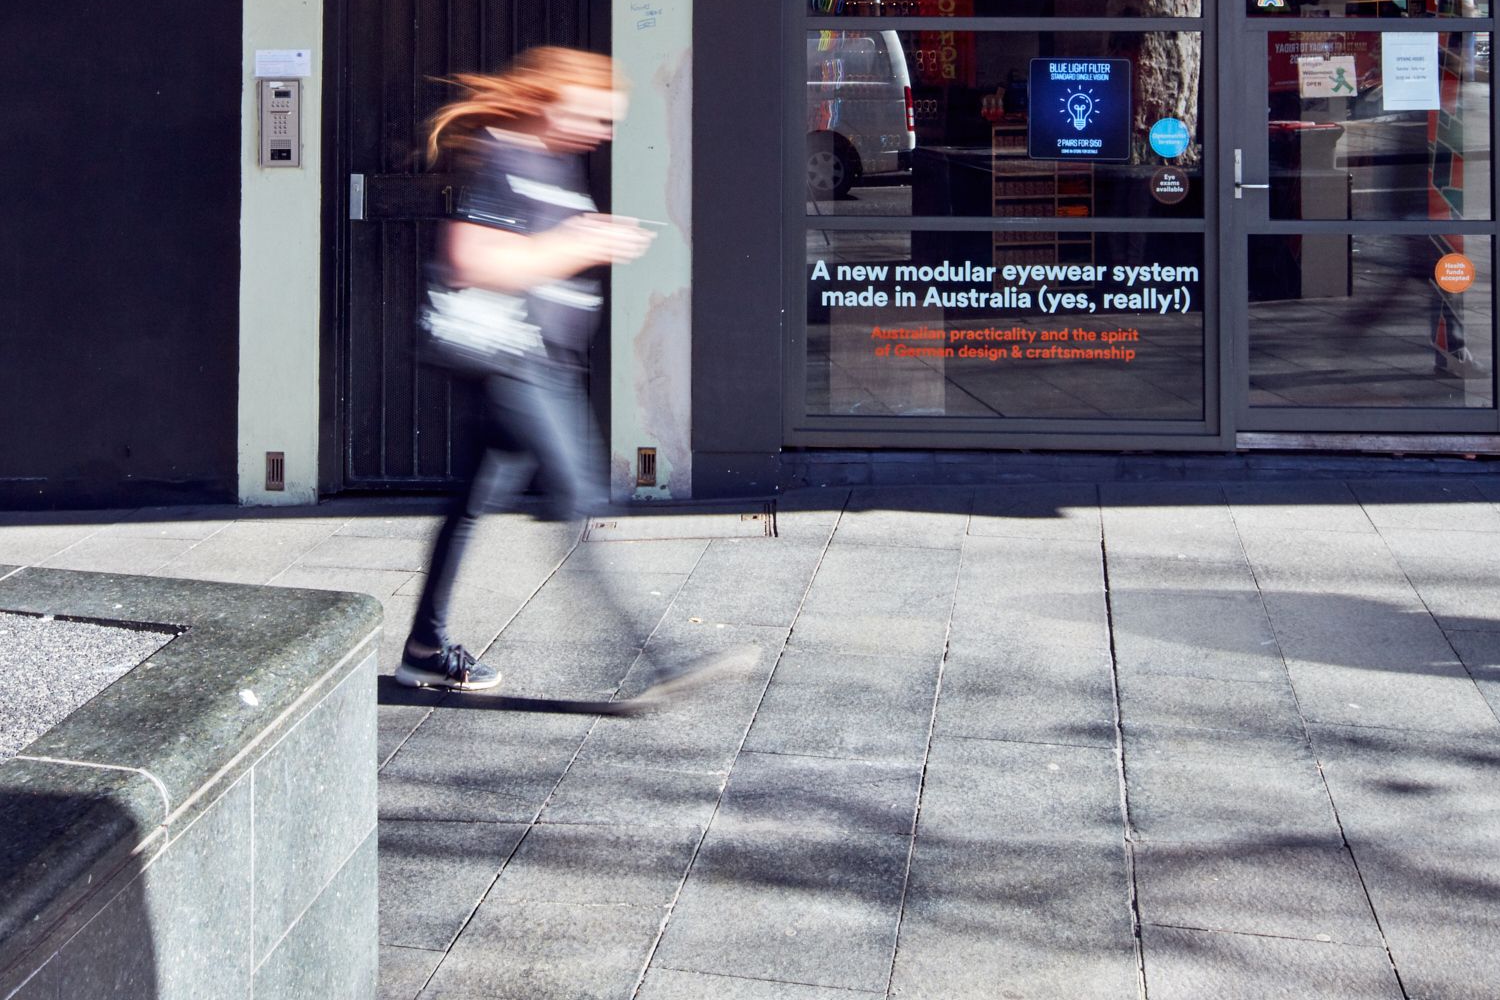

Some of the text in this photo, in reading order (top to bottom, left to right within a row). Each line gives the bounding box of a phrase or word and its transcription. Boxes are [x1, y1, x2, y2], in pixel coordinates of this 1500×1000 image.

[1050, 63, 1110, 74] BLUE LIGHT FILTER
[1057, 138, 1062, 147] 2
[1062, 138, 1078, 147] PAIRS
[1078, 139, 1089, 147] FOR
[811, 260, 1199, 286] A new modular eyewear system
[822, 284, 1191, 314] made in Australia (yes, really!)
[870, 326, 1140, 344] Australian practicality and the spirit
[874, 343, 1136, 362] of German design & craftsmanship
